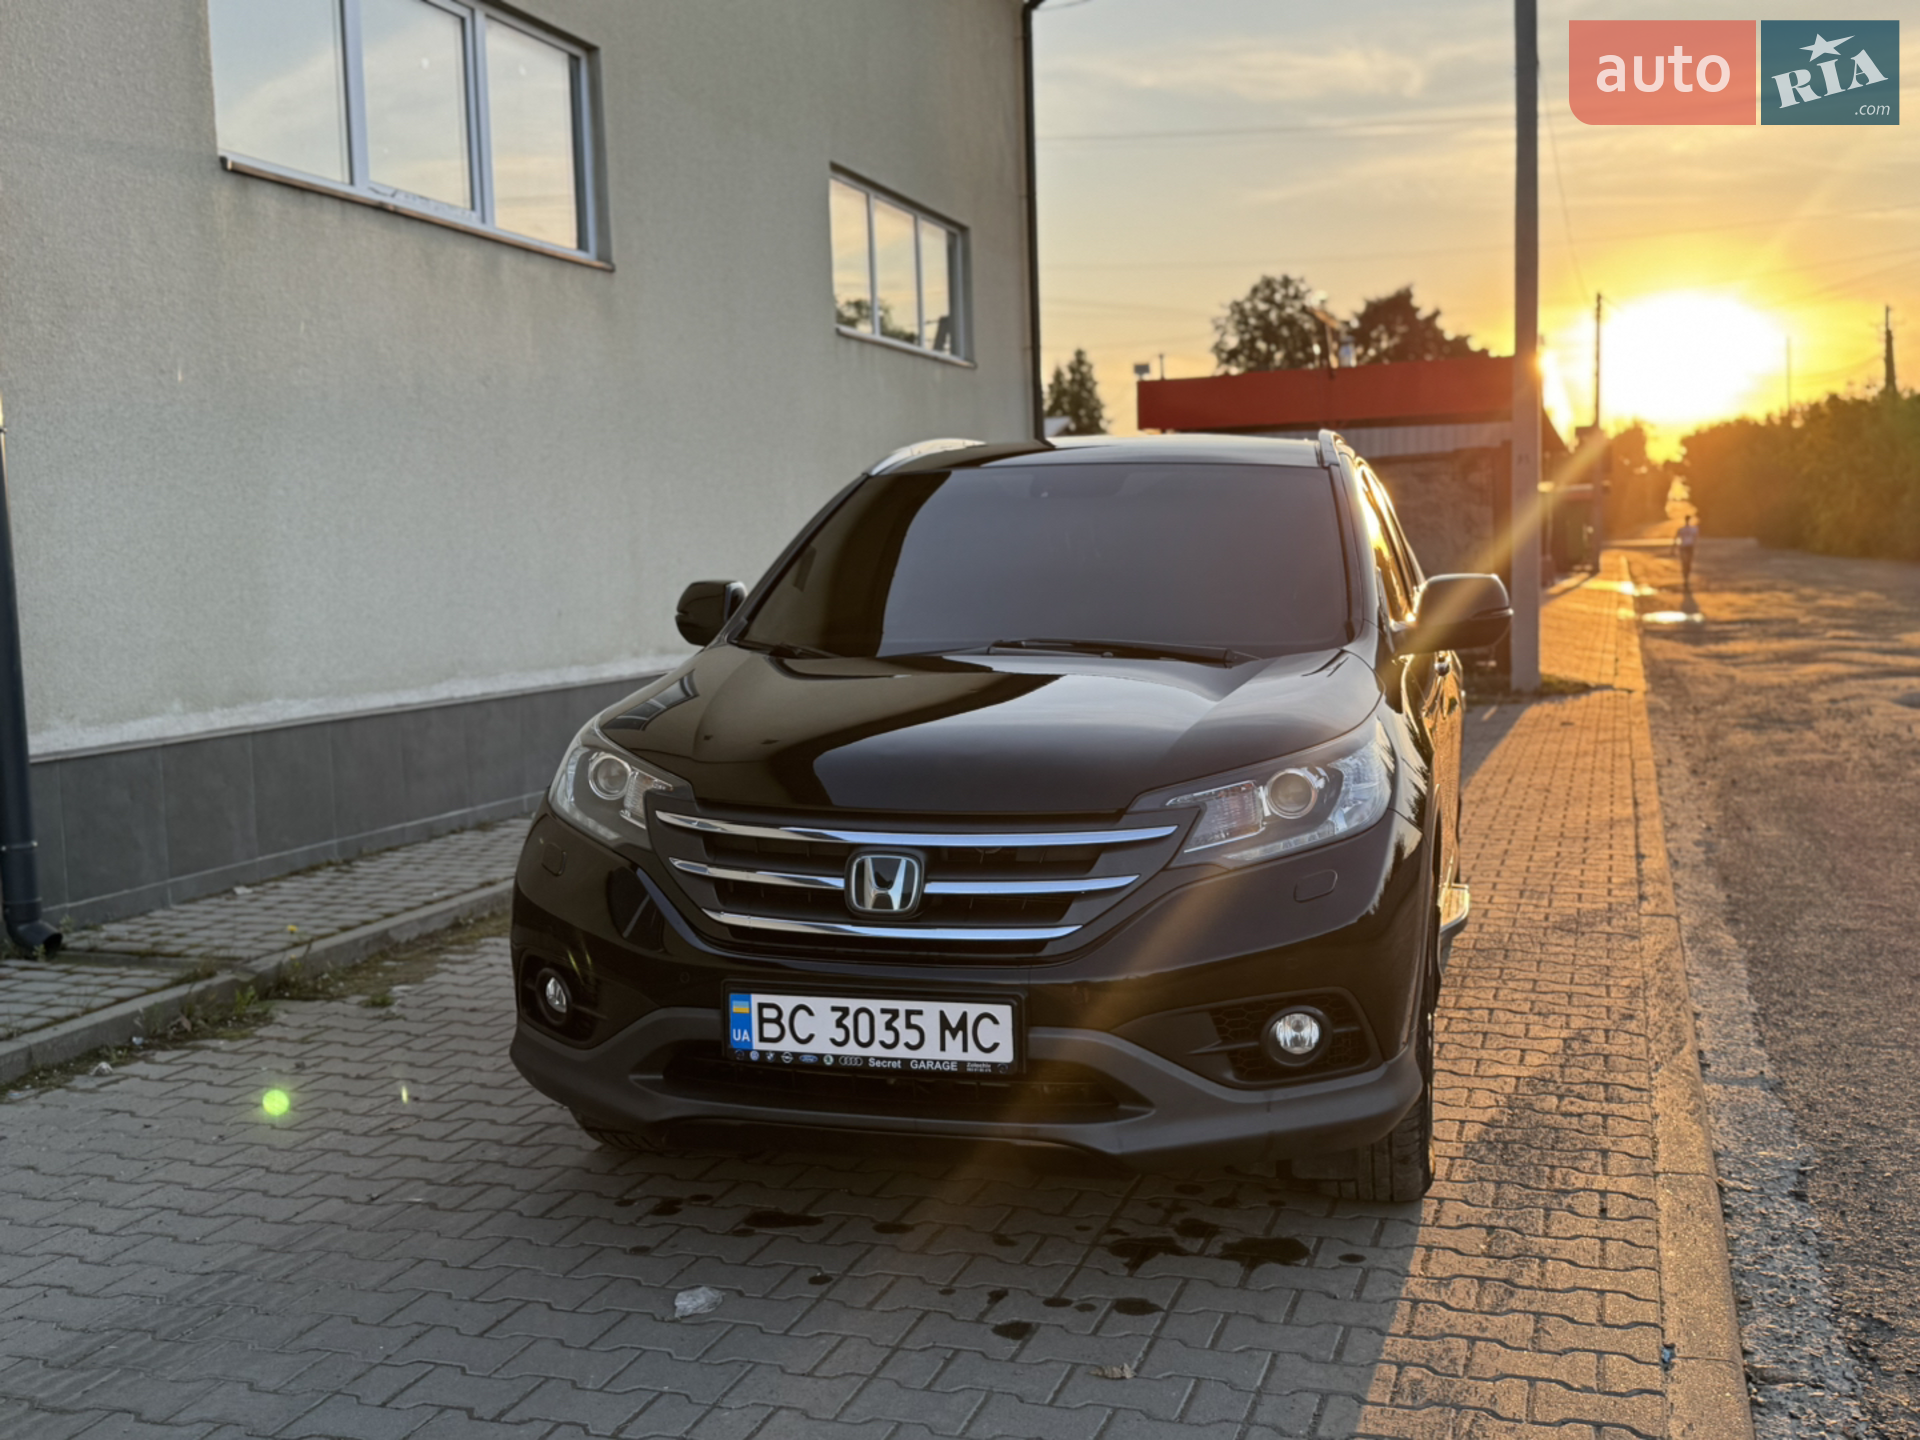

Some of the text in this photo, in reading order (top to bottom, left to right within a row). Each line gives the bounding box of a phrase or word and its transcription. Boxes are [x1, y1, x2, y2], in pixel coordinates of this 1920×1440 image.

[732, 1028, 751, 1043] UA
[756, 1002, 1000, 1054] BC 3035 MC
[867, 1057, 902, 1069] Secret
[910, 1060, 959, 1072] GARAGE
